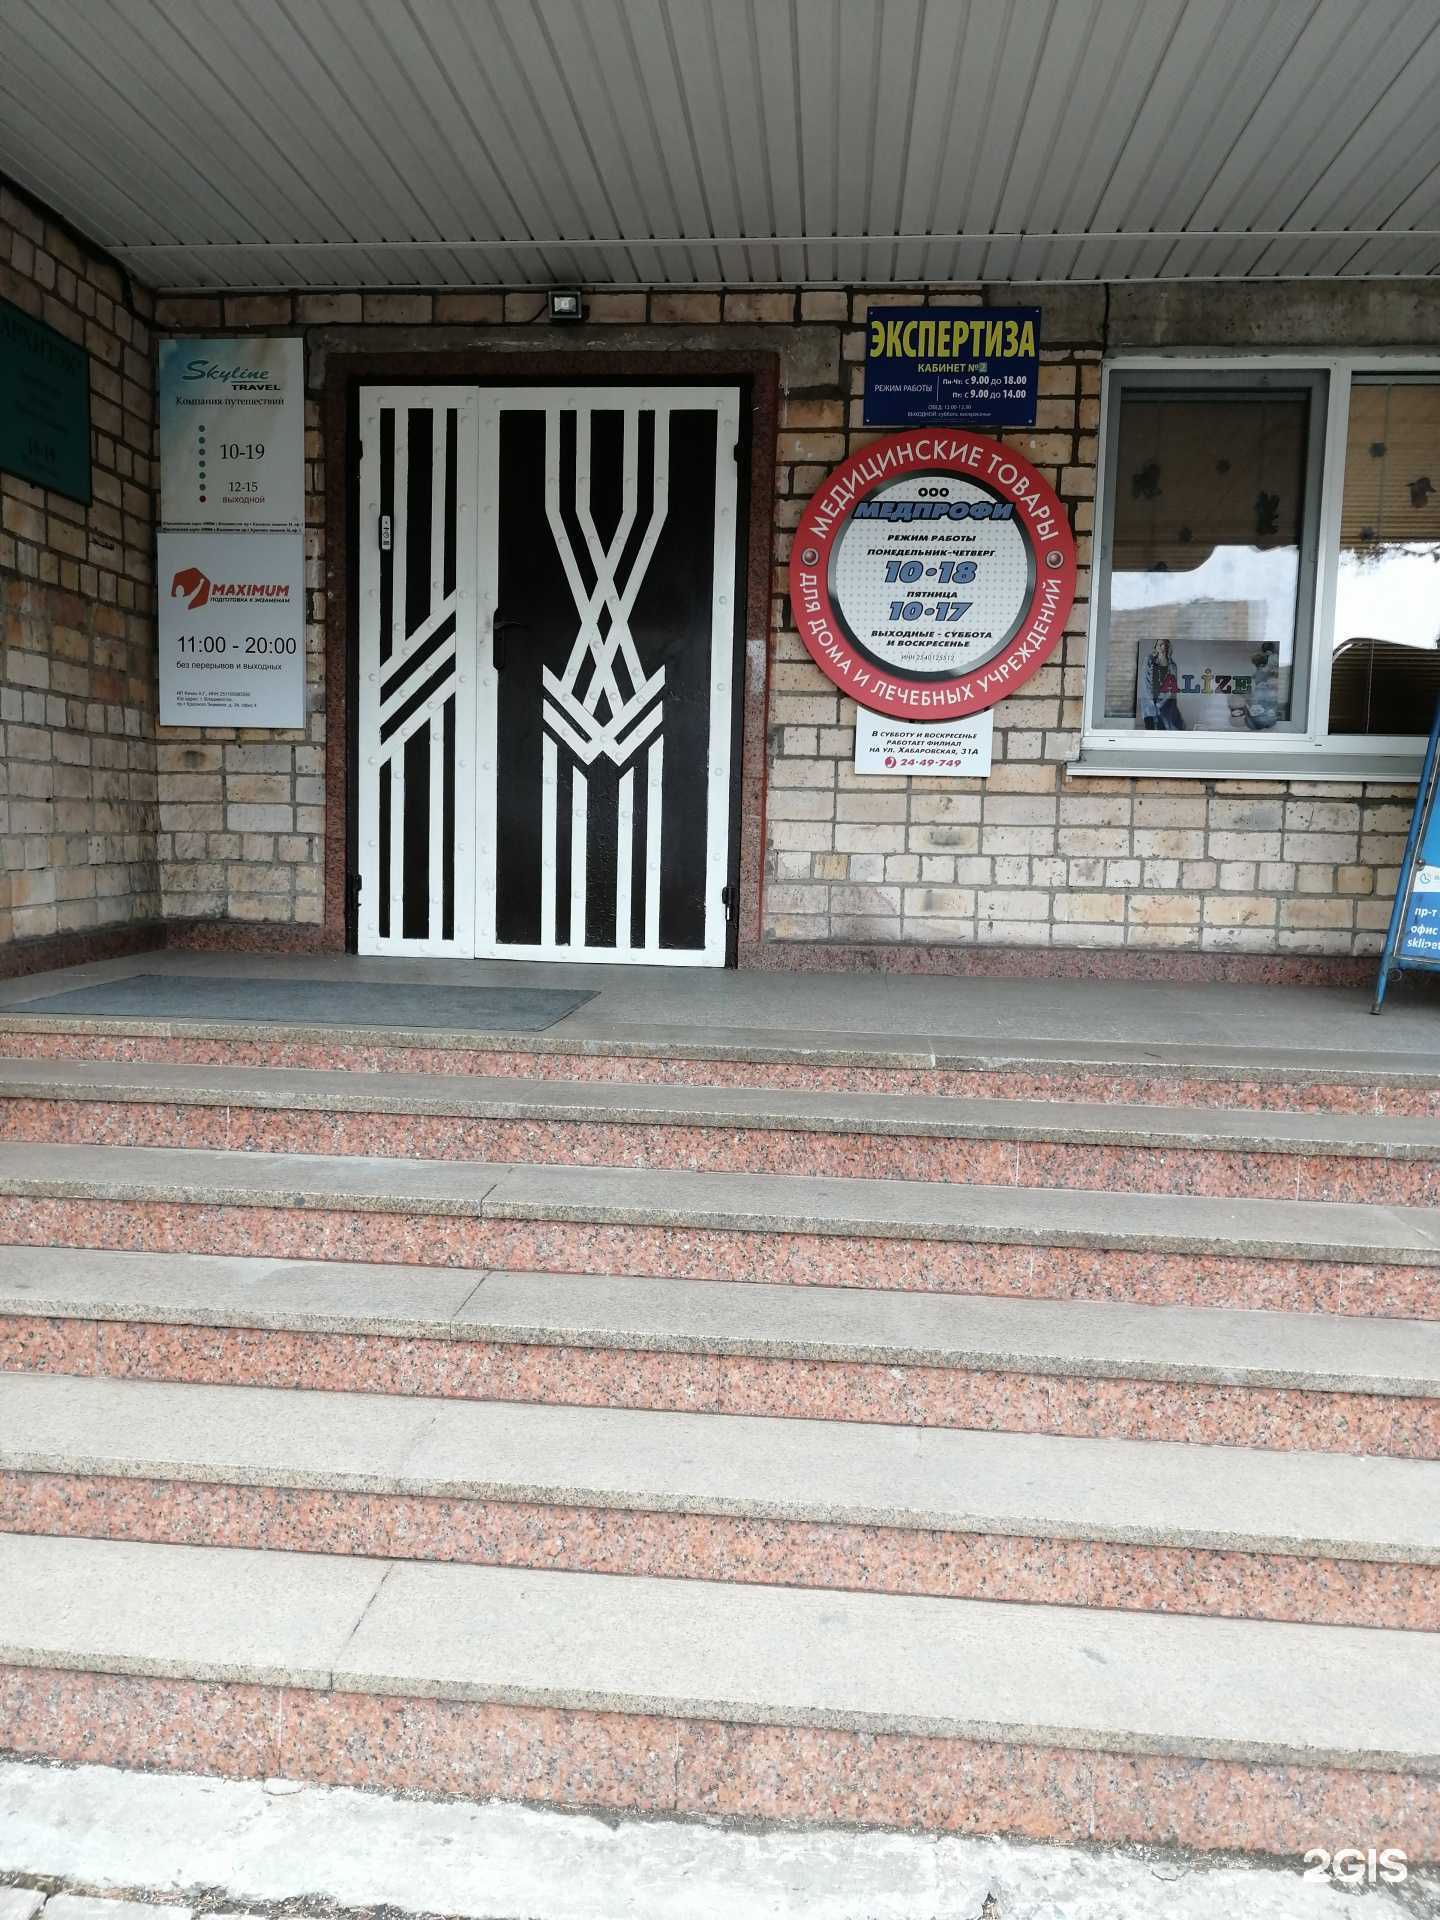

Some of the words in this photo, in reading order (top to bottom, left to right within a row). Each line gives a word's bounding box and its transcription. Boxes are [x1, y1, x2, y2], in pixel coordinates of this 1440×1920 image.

[870, 320, 1036, 358] ЭКСПЕРТИЗА
[182, 360, 269, 382] Skyline
[918, 363, 966, 373] КАБИНЕТ
[970, 376, 989, 385] 9.00
[1003, 376, 1027, 385] 18.00
[874, 384, 902, 392] РЕЖИМ
[903, 384, 933, 392] РАБОТЫ
[970, 390, 989, 398] 9.00
[1003, 390, 1026, 398] 14.00
[176, 395, 222, 405] Компания
[224, 396, 284, 407] путешествий
[220, 443, 265, 460] 10-19
[229, 482, 258, 492] 12-15
[810, 439, 984, 539] МЕДИЦИНСКИЕ
[988, 453, 1060, 541] ТОВАРЫ
[917, 487, 949, 497] ООО
[852, 501, 1015, 522] МЕДПРОФИ
[887, 534, 929, 542] РЕЖИМ
[930, 534, 976, 542] РАБОТЫ
[867, 548, 995, 557] ПОНЕДЕЛЬНИК-ЧЕТВЕРГ
[211, 584, 290, 597] MAXIMUM
[799, 572, 820, 612] ДЛЯ
[906, 590, 958, 599] ПЯТНИЦА
[870, 630, 935, 639] ВЫХОДНЫЕ
[944, 631, 993, 639] СУББОТА
[976, 578, 1062, 694] УЧРЕЖДЕНИЙ
[177, 635, 226, 653] 11:00
[245, 637, 297, 654] 20:00
[807, 616, 851, 676] ДОМА
[886, 640, 895, 648] И
[897, 640, 970, 648] ВОСКРЕСЕНЬЕ
[176, 661, 190, 669] без
[192, 662, 234, 671] перерывов
[243, 663, 282, 671] выходных
[854, 672, 868, 688] И
[871, 681, 975, 706] ЛЕЧЕБНЫХ
[1414, 907, 1438, 918] пр-т
[1410, 924, 1439, 936] офис
